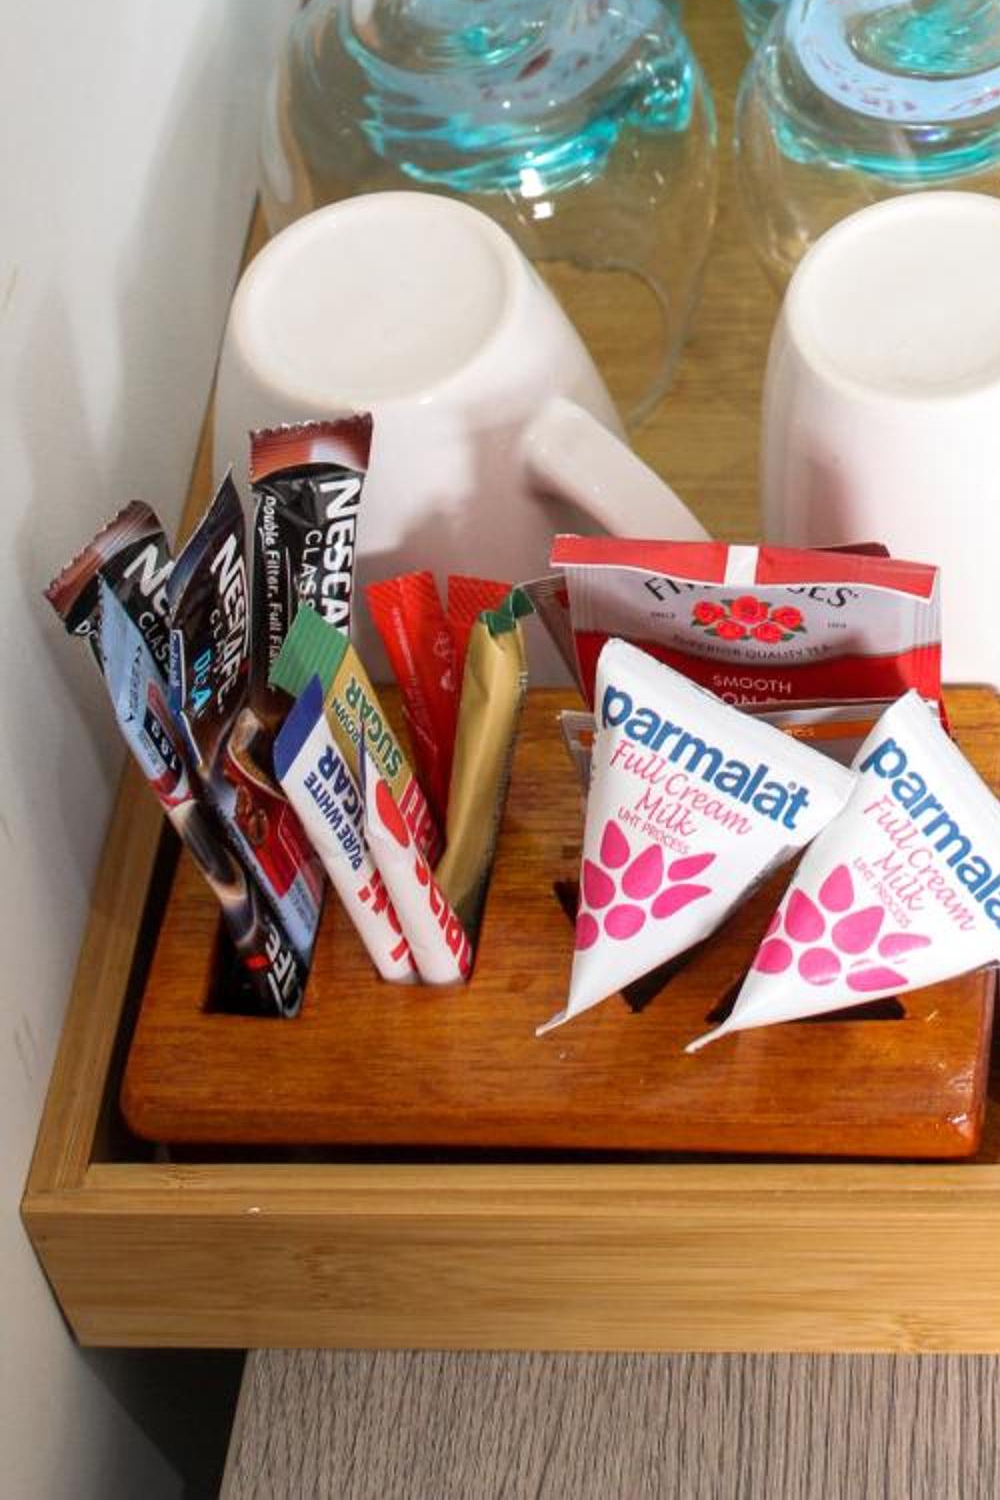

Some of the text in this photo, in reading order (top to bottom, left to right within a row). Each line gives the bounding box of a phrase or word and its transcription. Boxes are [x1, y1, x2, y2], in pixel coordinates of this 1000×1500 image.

[299, 530, 323, 610] CLAS
[319, 477, 361, 636] NESCA
[138, 611, 170, 673] CLAS
[743, 648, 803, 661] QUALITY
[713, 675, 791, 693] SMOOTH
[332, 697, 361, 746] ROWN
[602, 684, 809, 830] parmalat
[610, 739, 752, 835] Full Cream
[303, 771, 340, 826] WHITE
[317, 745, 366, 835] GAR
[635, 787, 696, 836] Milk
[618, 807, 690, 854] UHT PROCESS
[864, 795, 976, 931] Full Cream
[873, 850, 925, 911] Milk
